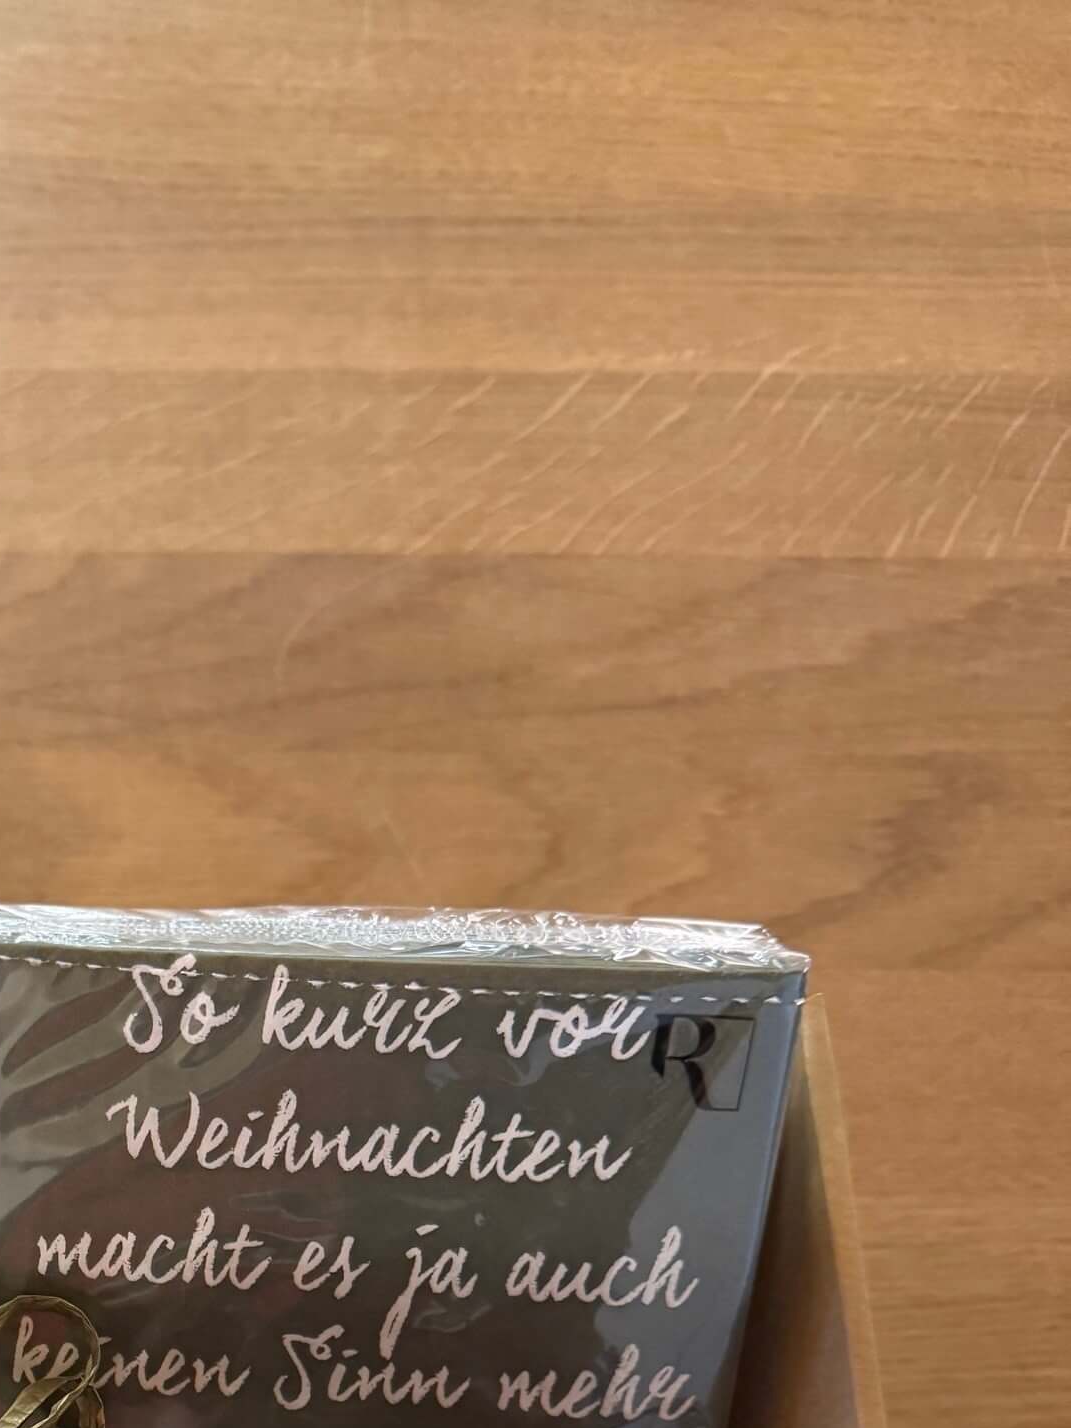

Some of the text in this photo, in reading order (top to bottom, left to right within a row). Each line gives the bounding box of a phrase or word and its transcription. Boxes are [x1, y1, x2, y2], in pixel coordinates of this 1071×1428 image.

[124, 955, 652, 1060] So kurz vor
[106, 1089, 632, 1182] Weihnachten
[37, 1207, 698, 1358] macht es ja auch
[273, 1326, 470, 1411] Sinn
[496, 1345, 697, 1422] mehr
